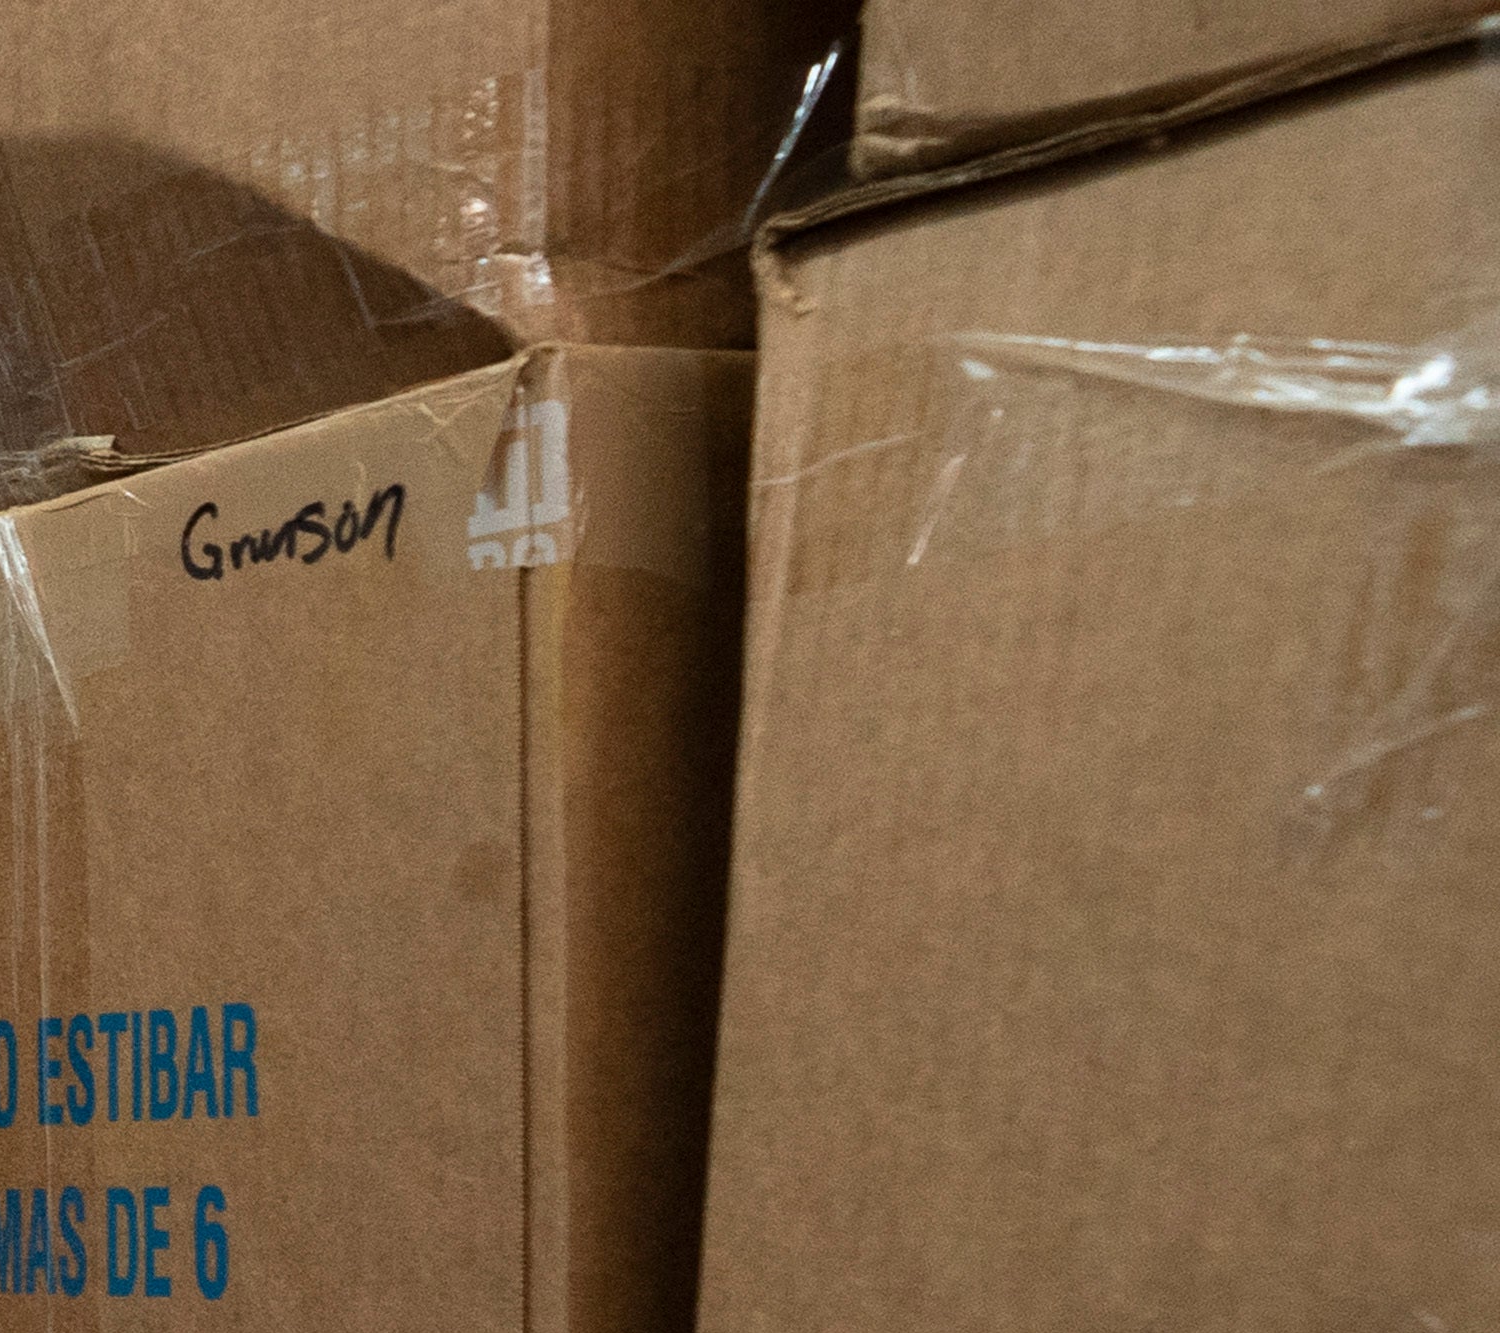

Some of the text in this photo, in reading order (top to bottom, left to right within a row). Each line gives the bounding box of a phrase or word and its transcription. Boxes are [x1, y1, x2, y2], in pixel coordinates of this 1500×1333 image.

[36, 1002, 260, 1127] ESTIBAR
[105, 1186, 173, 1299] DE
[192, 1184, 230, 1301] 6
